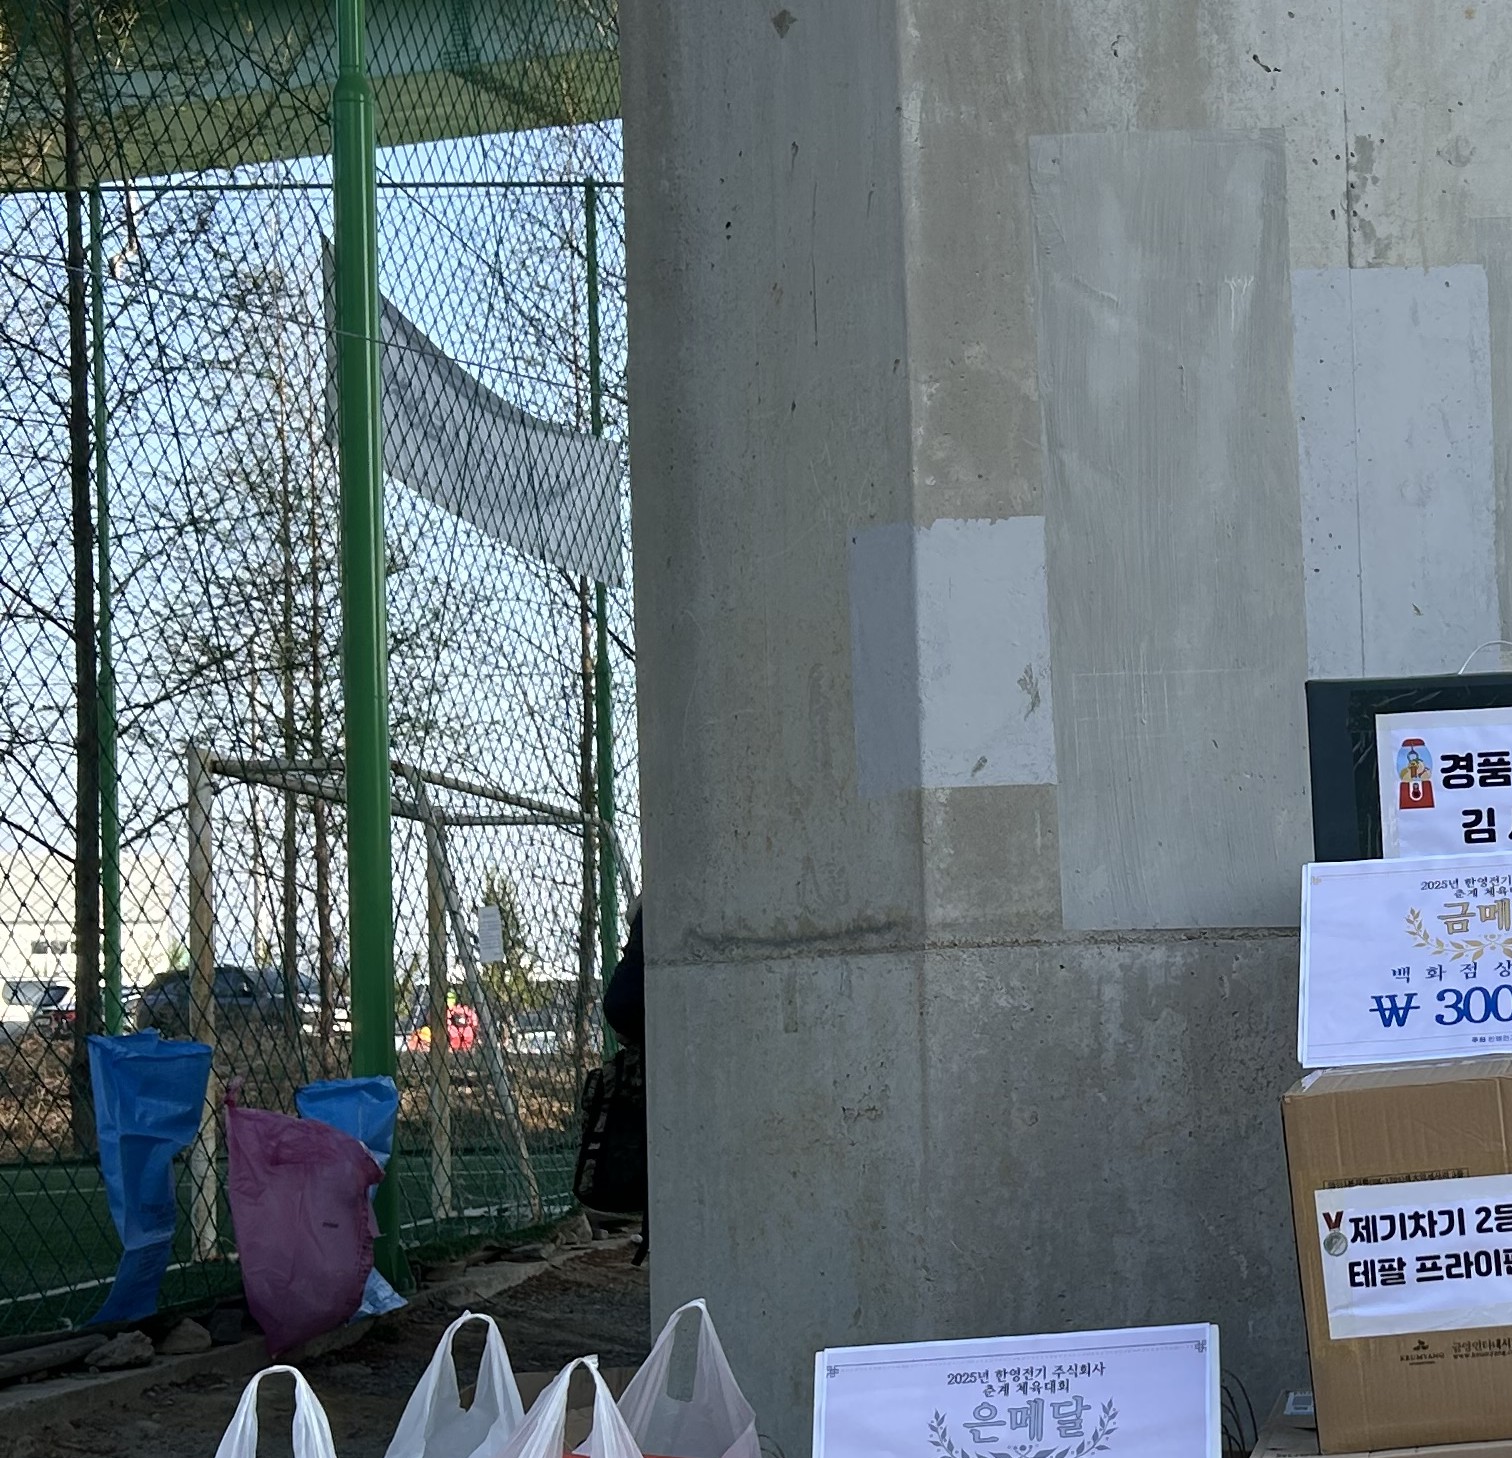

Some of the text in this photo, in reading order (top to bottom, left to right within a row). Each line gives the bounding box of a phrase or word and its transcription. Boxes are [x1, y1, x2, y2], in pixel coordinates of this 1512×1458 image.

[1439, 750, 1512, 790] 경품
[1461, 808, 1497, 845] 김
[1420, 878, 1459, 891] 2025년
[1348, 1208, 1466, 1245] 제기차기
[1347, 1256, 1407, 1288] 테팔
[947, 1361, 1107, 1385] 2025년 한영전기 주식회사
[1016, 1378, 1070, 1396] 체육대회
[962, 1394, 1092, 1444] 은메달
